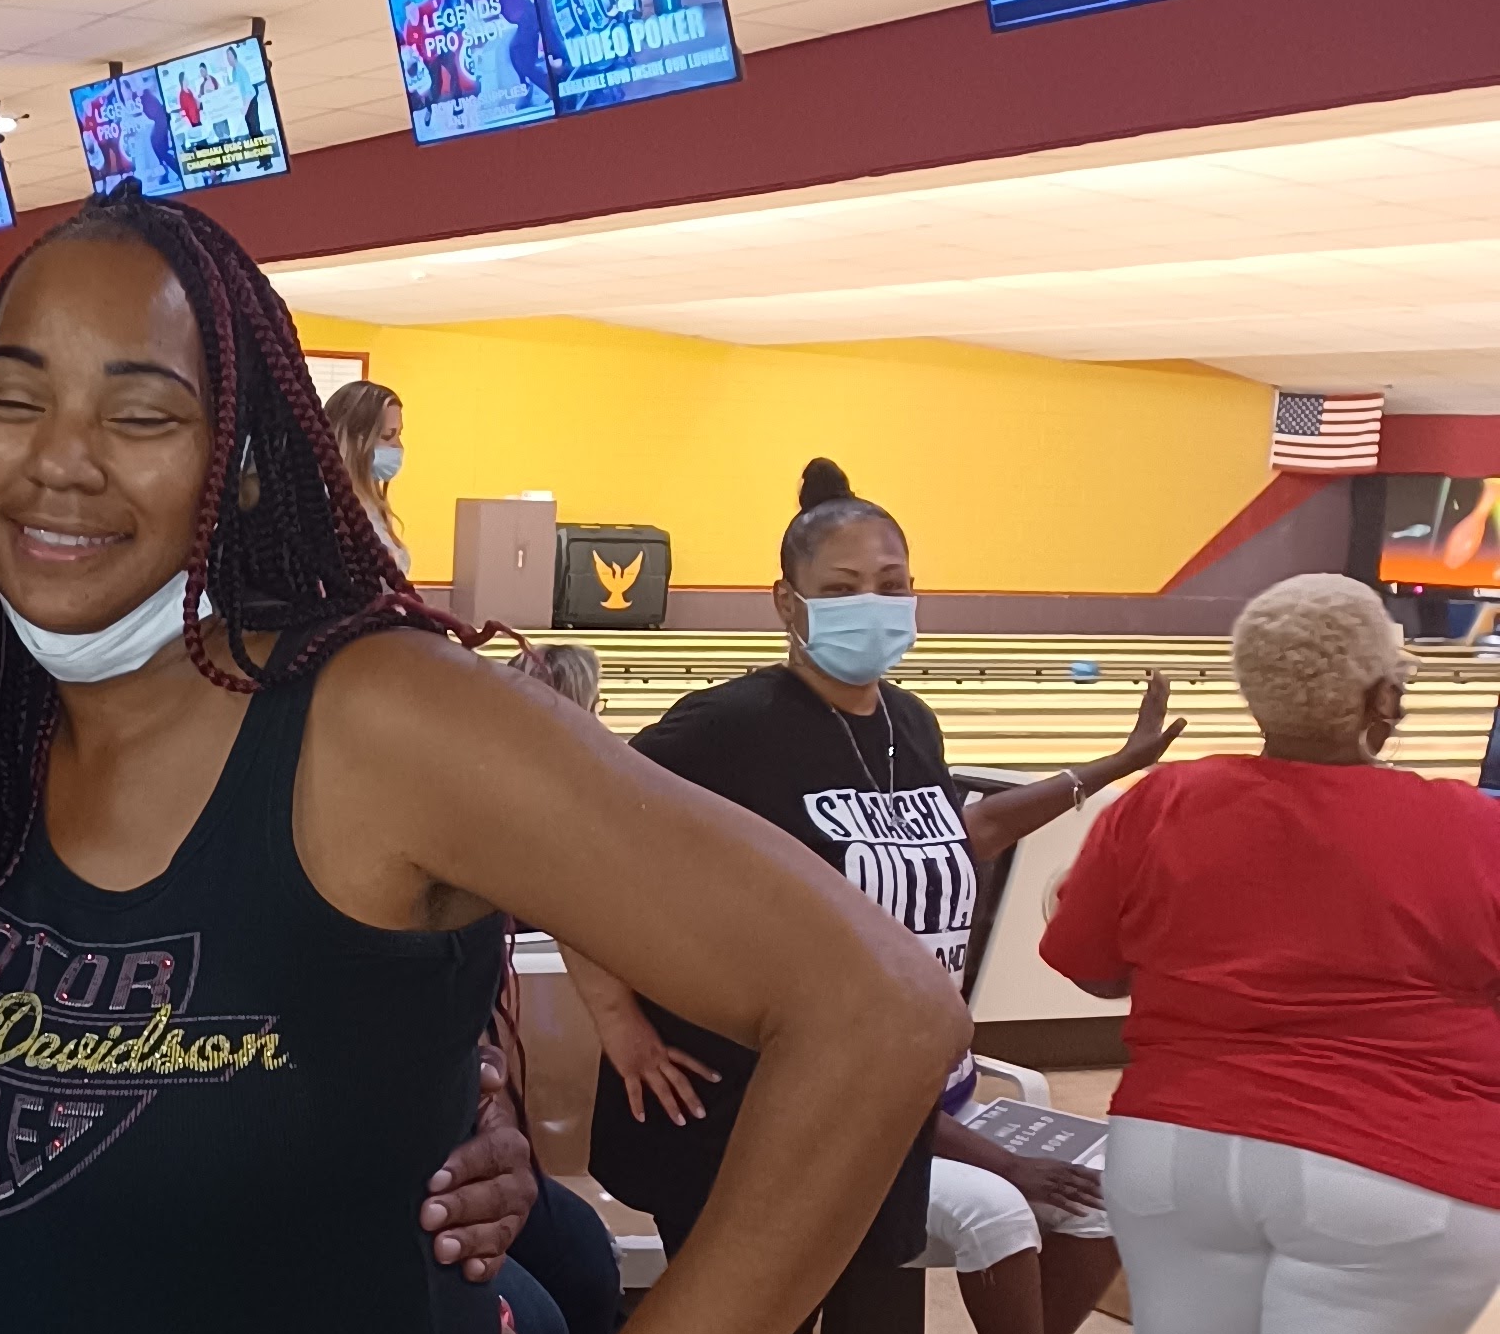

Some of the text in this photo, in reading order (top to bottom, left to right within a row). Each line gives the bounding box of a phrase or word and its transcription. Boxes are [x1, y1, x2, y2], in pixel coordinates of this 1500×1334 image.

[424, 32, 459, 57] PRO
[564, 6, 707, 68] VIDEO POKER
[845, 841, 977, 932] OUTTA
